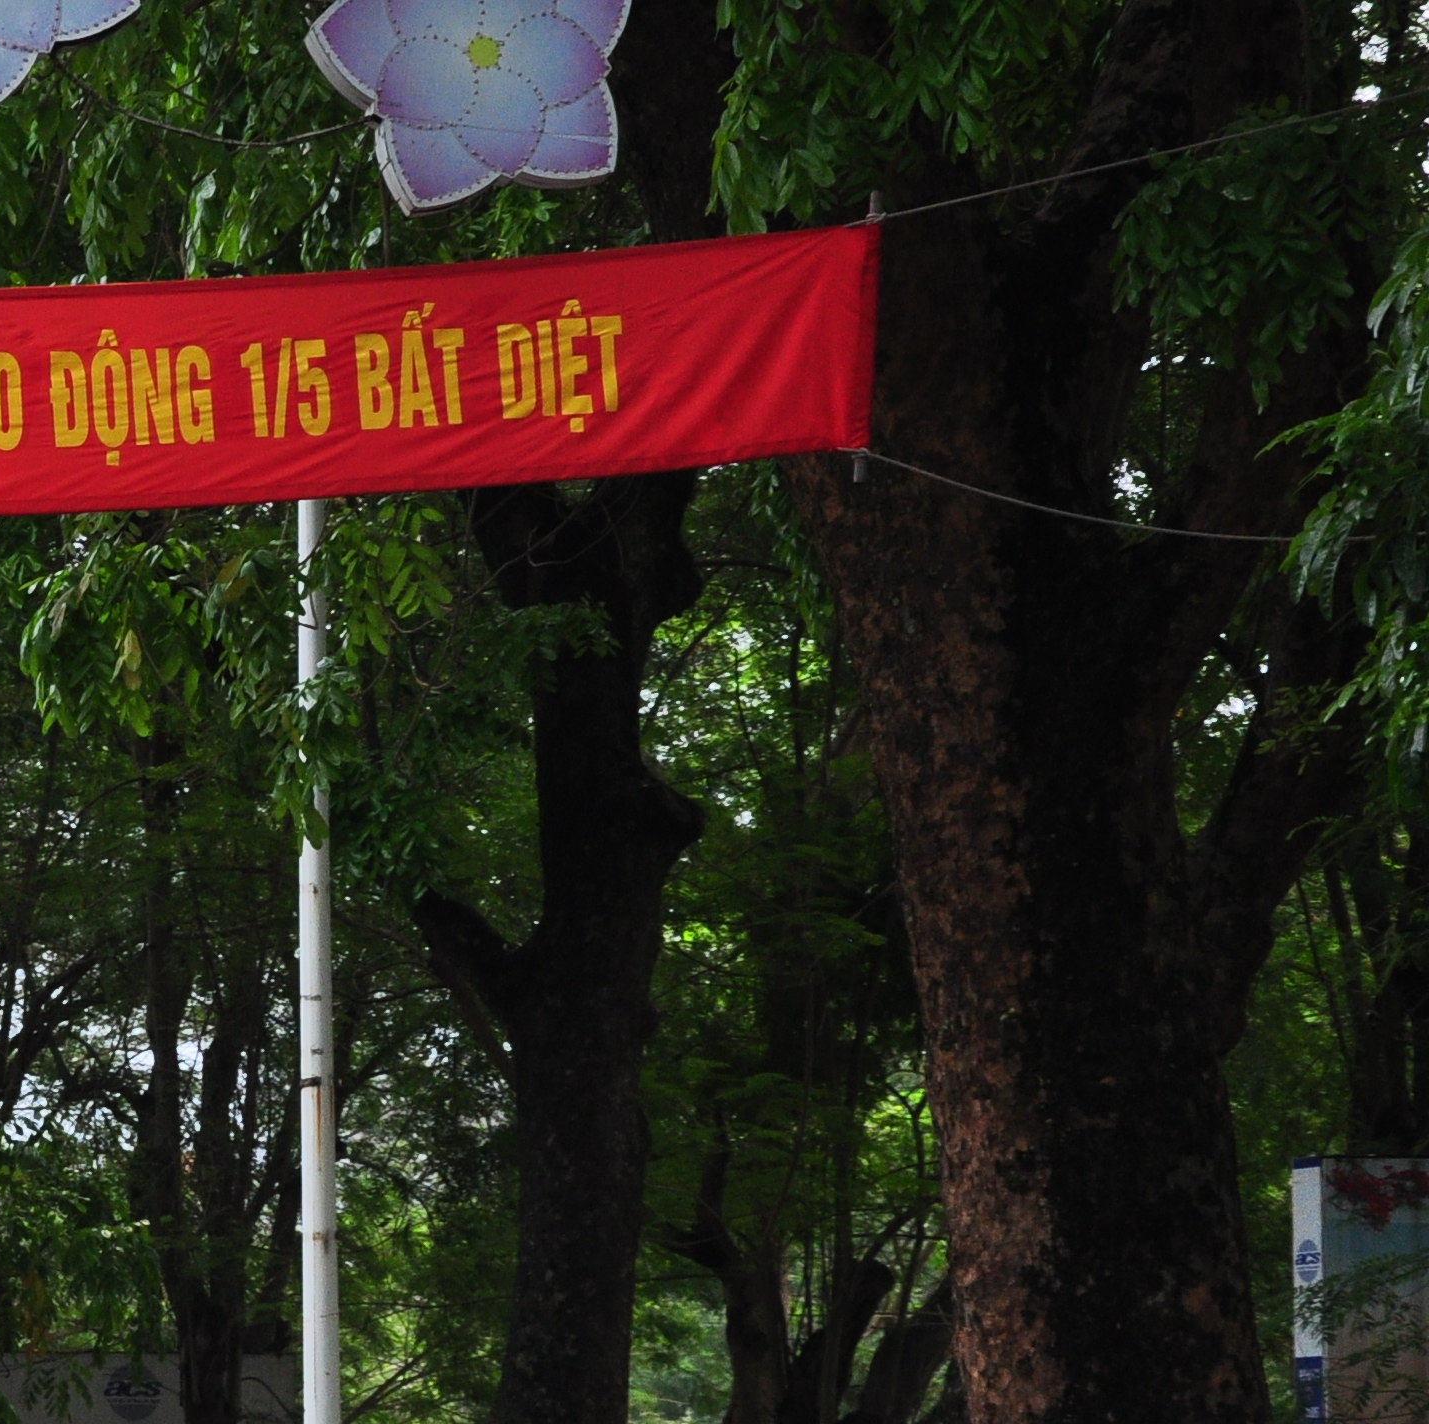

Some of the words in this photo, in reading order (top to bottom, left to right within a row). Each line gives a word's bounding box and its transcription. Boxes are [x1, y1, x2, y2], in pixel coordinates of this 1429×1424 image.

[49, 329, 215, 466] ĐỘNG
[240, 337, 331, 438] 1/5
[355, 302, 464, 430] BẤT
[496, 299, 622, 433] DIỆT
